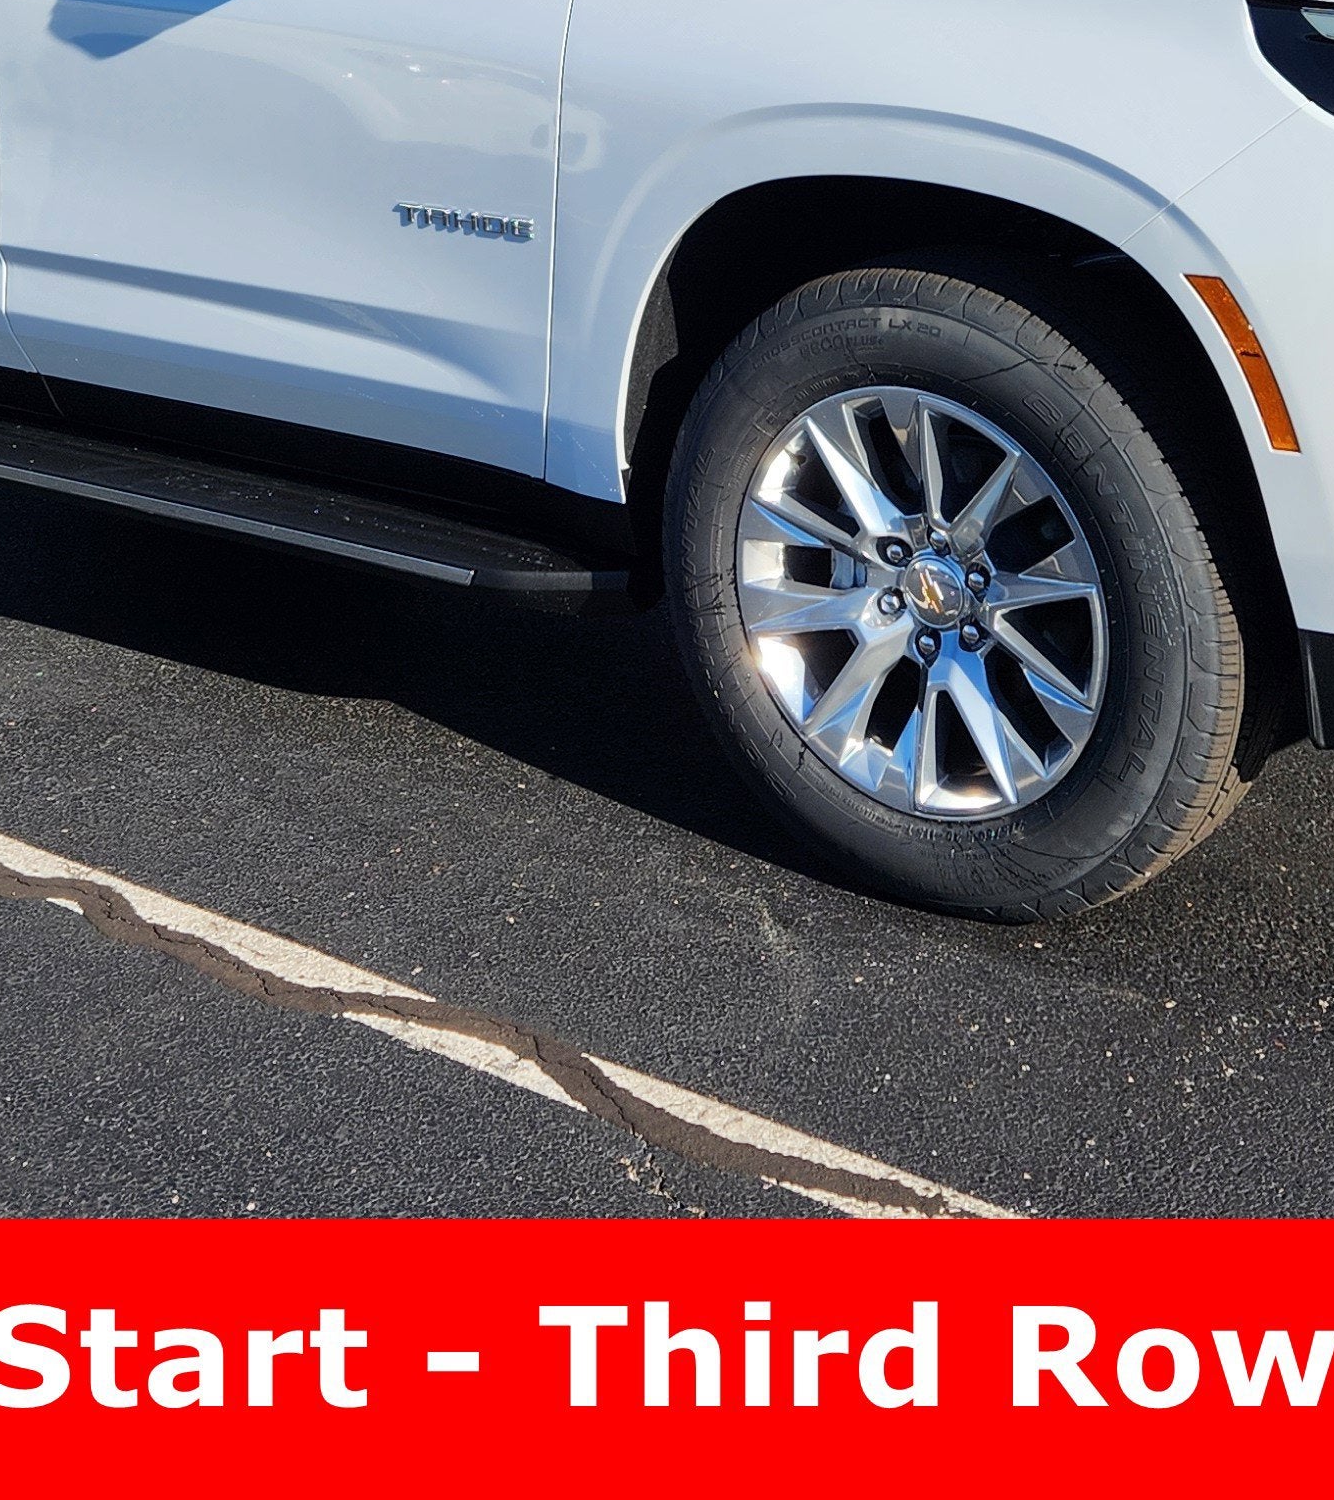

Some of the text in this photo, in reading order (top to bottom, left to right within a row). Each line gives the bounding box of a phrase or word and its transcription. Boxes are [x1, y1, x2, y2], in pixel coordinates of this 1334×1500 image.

[396, 202, 535, 240] TAHOE
[888, 319, 913, 332] LX
[916, 322, 942, 338] 20
